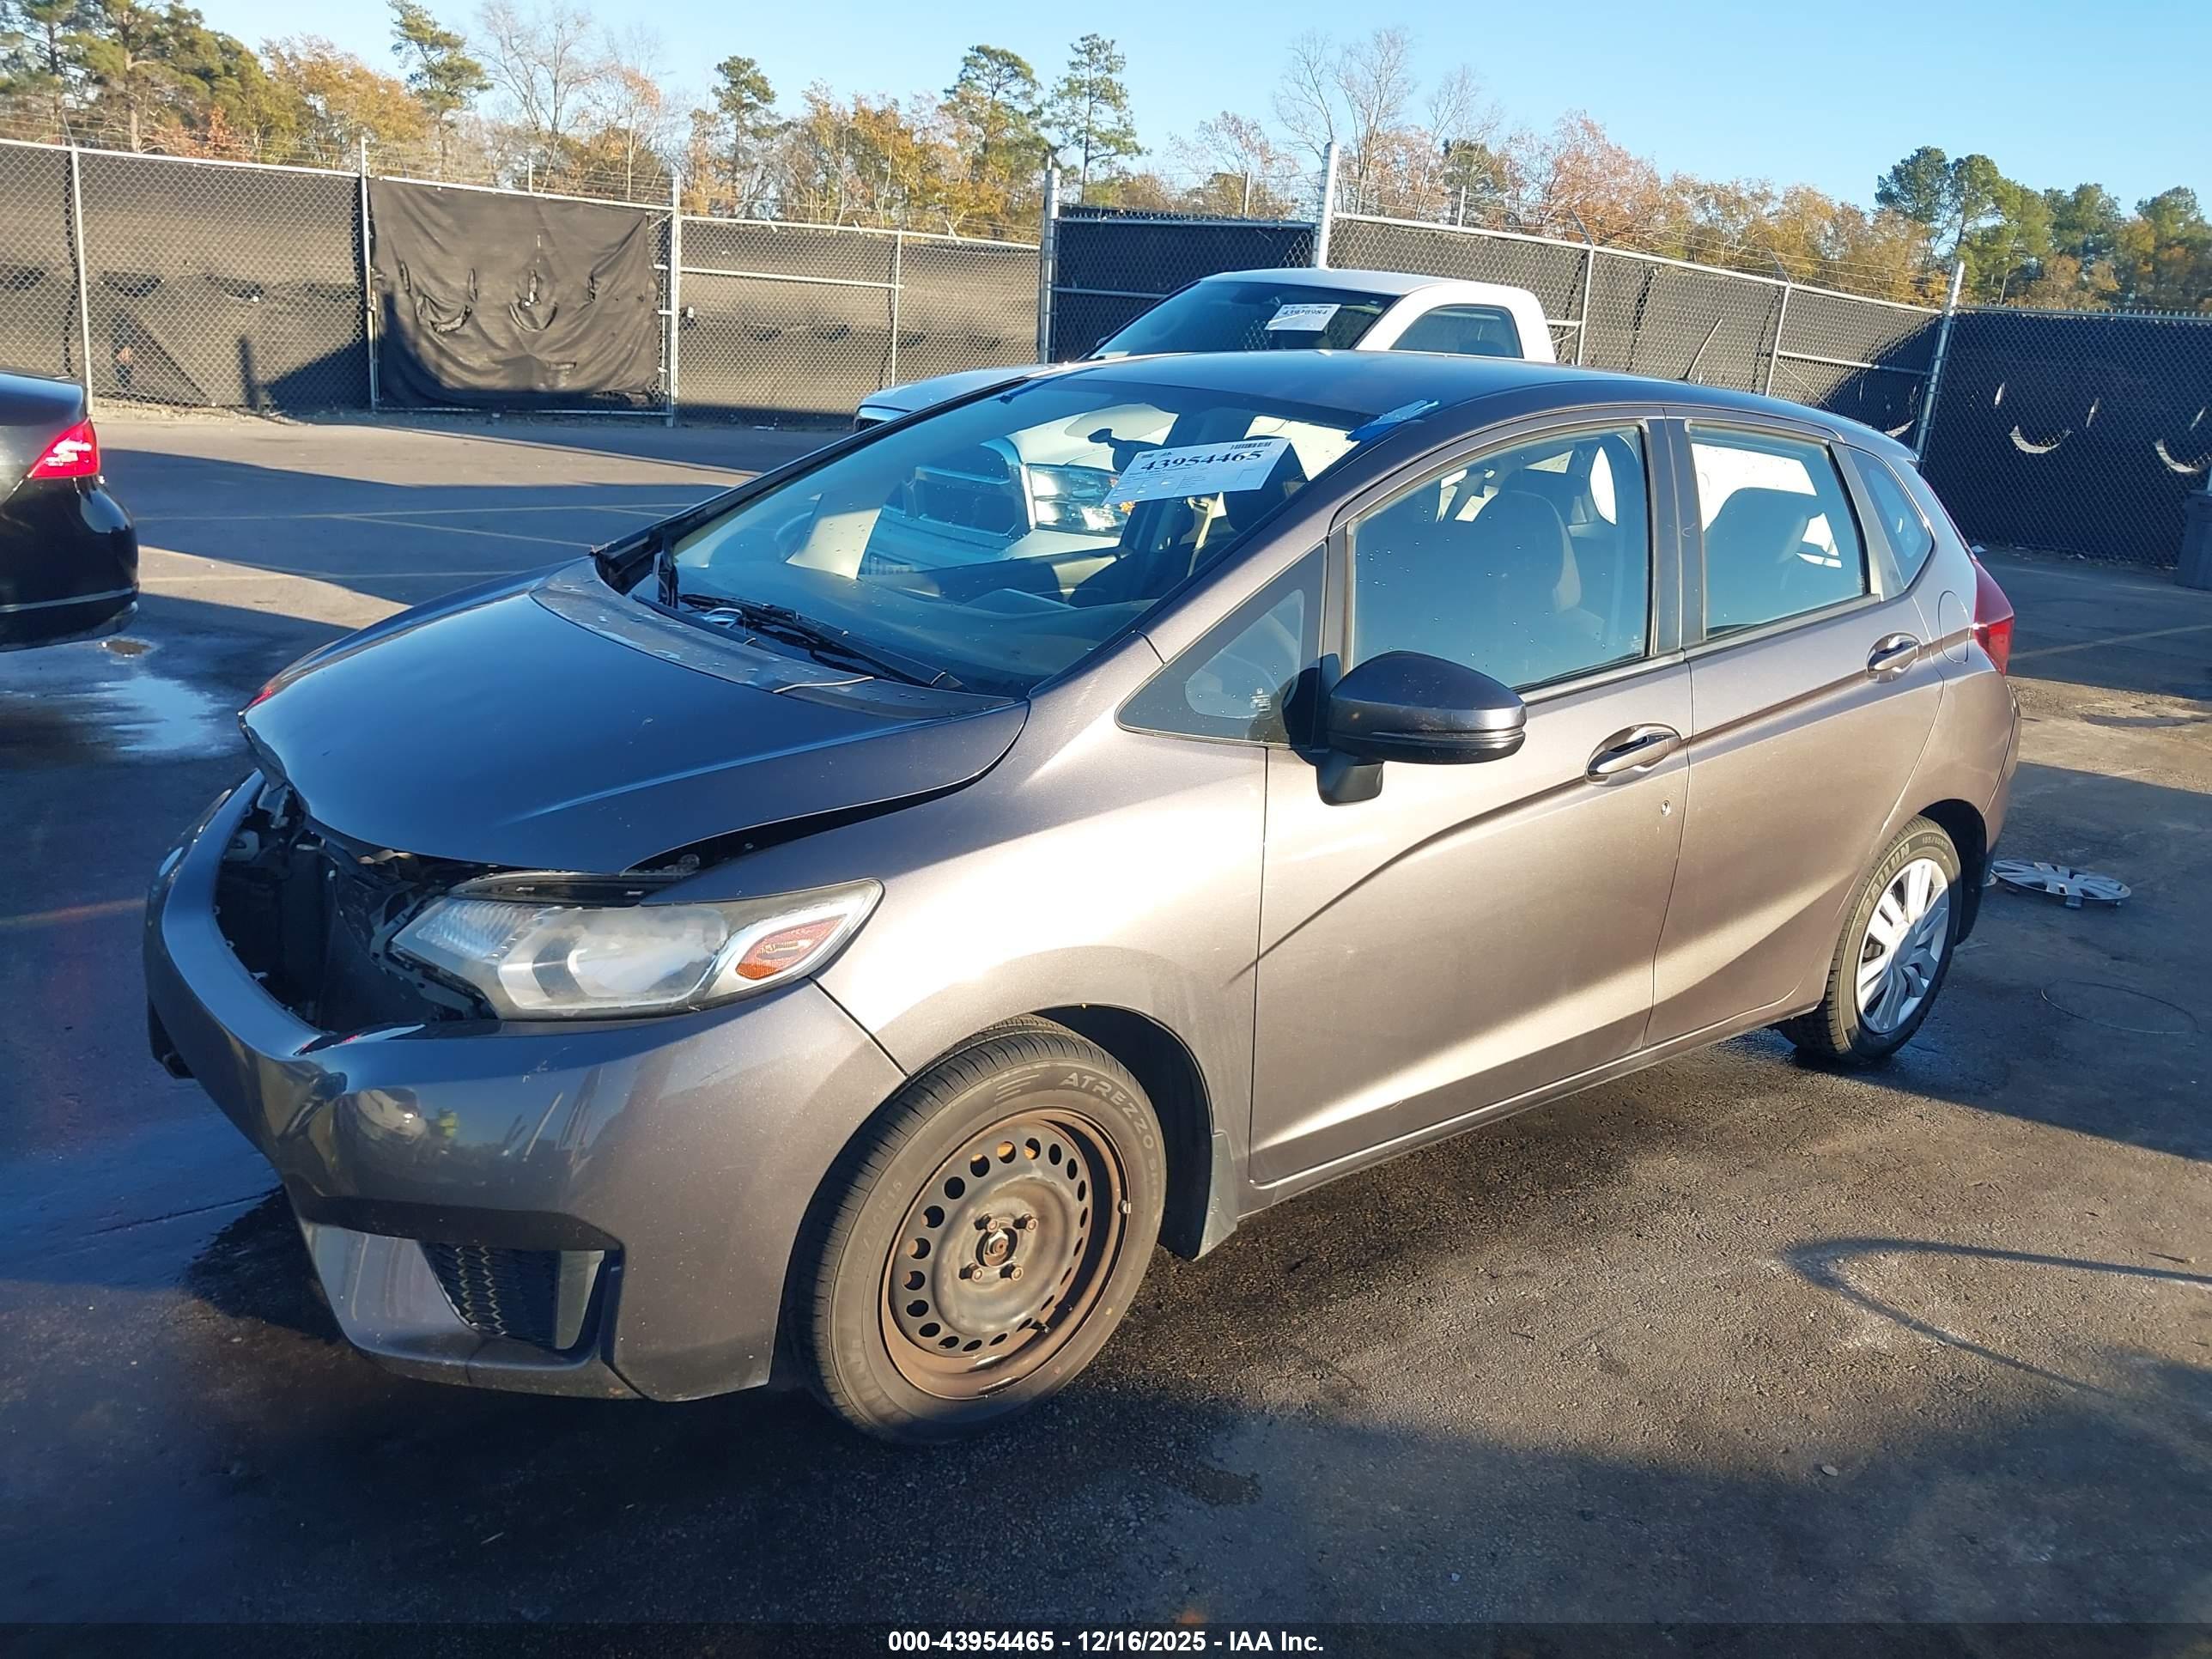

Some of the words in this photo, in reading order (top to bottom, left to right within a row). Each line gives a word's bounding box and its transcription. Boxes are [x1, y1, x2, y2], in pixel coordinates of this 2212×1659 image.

[1140, 451, 1263, 471] 43954465
[1863, 842, 1910, 915] SAILUN
[1060, 1073, 1155, 1149] ATREZZO
